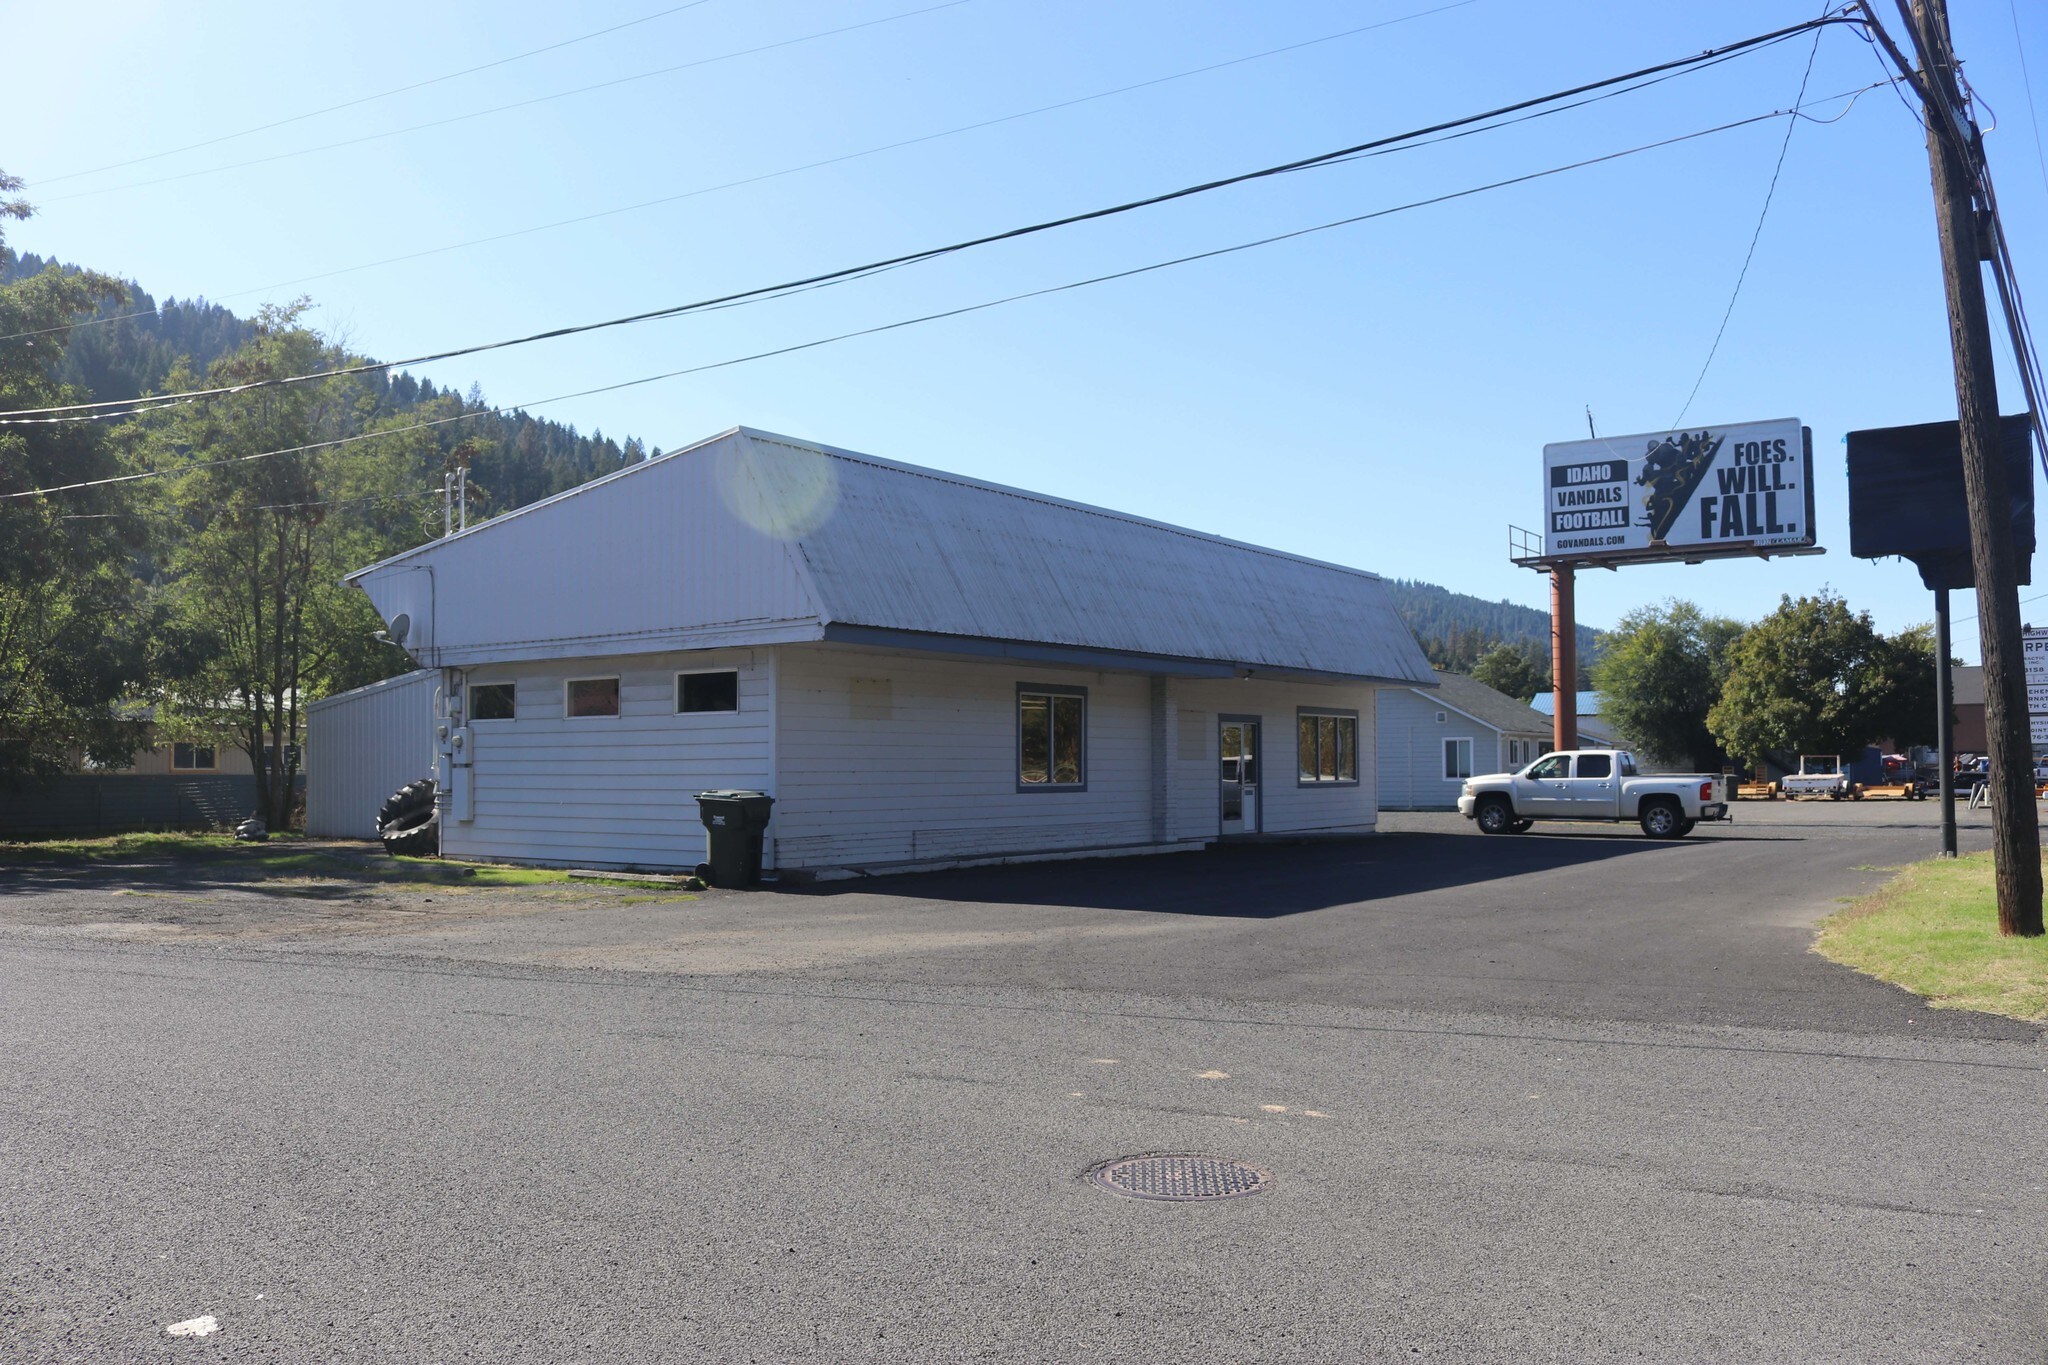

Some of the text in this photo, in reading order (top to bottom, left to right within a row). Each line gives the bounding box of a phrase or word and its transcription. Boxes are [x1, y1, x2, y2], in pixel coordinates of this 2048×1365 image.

[1734, 438, 1795, 467] FOES.
[1567, 463, 1611, 484] IDAHO
[1717, 463, 1796, 495] WILL.
[1557, 486, 1622, 507] VANDALS
[1555, 509, 1625, 531] FOOTBALL
[1700, 491, 1797, 539] FALL.
[1556, 535, 1625, 549] GOVANDALS.COM
